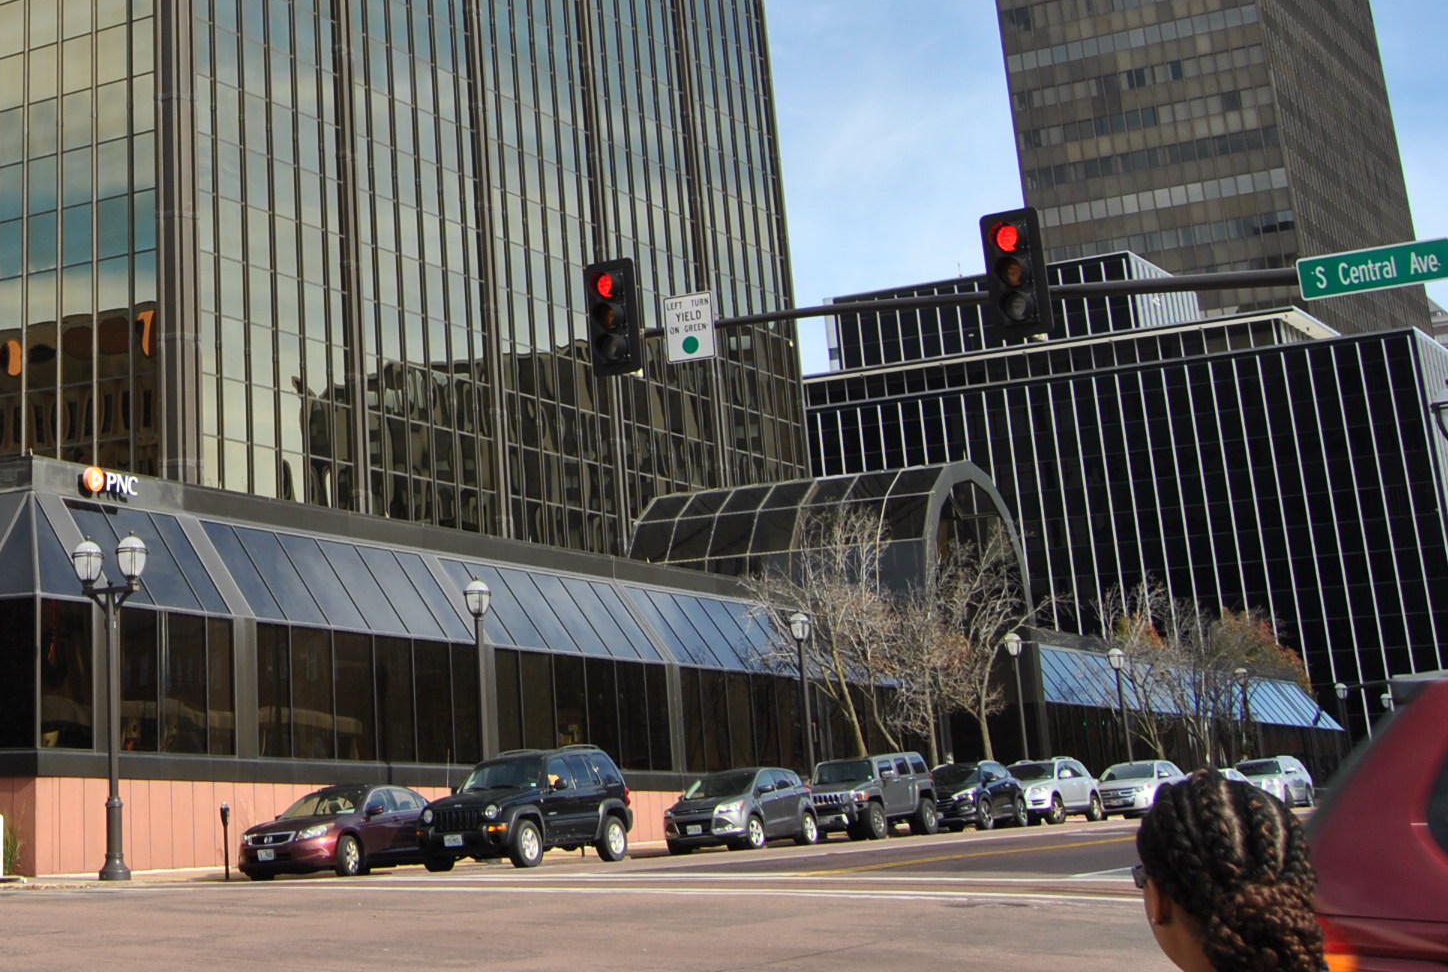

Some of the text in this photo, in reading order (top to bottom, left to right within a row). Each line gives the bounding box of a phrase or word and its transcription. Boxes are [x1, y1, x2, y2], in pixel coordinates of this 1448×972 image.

[1315, 252, 1439, 288] S Central Ave
[666, 298, 709, 311] LEFT TURN
[676, 310, 702, 322] YIELD
[669, 323, 707, 335] ON GREEN
[105, 471, 139, 496] PNC
